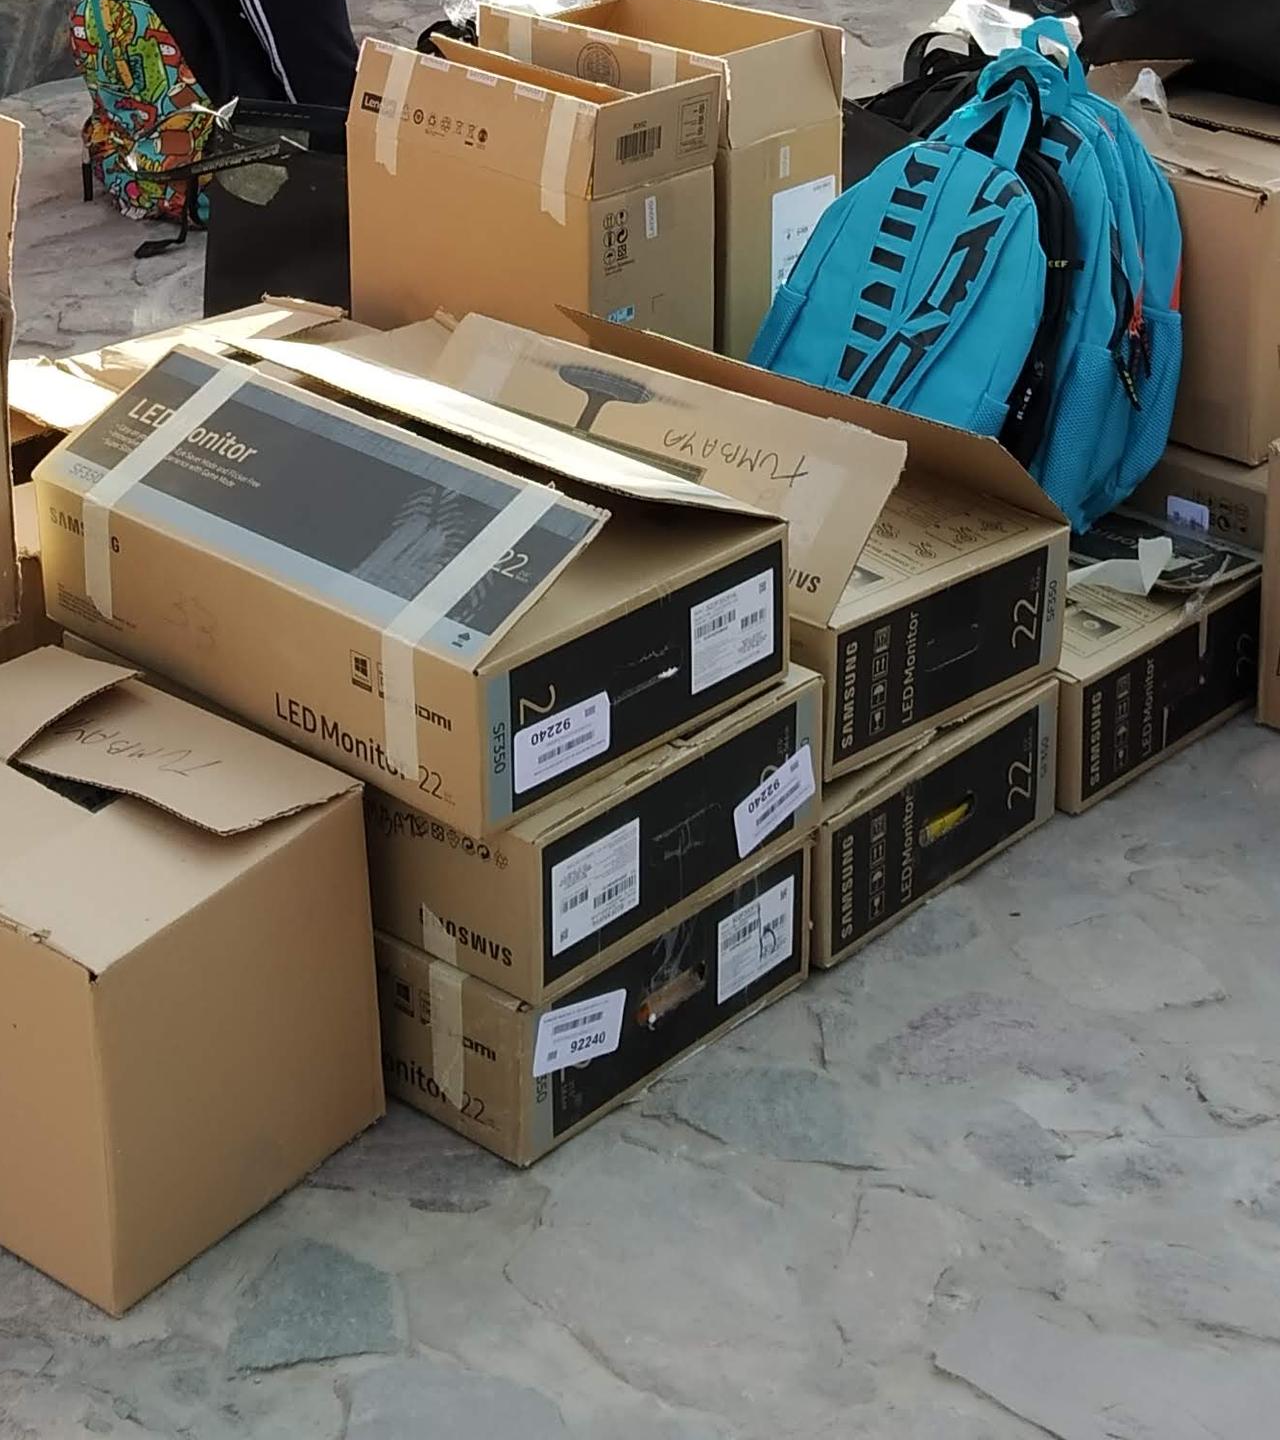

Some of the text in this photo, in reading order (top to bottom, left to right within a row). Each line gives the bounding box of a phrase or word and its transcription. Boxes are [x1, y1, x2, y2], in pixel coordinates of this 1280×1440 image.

[128, 398, 177, 428] LED
[187, 426, 258, 463] onitor
[663, 428, 809, 488] TUMBAYA
[49, 507, 120, 553] SAMG
[1011, 593, 1040, 649] 22
[415, 704, 452, 732] DMI
[841, 641, 858, 749] SAMSUNG
[321, 716, 406, 780] Monit
[492, 722, 506, 774] SF350
[531, 717, 571, 746] 92240
[1089, 691, 1103, 787] SAMSUNG
[418, 765, 443, 800] 22
[748, 778, 781, 814] 92240
[1007, 752, 1032, 810] 22
[841, 835, 855, 939] SAMSUNG
[420, 906, 513, 967] SAMSU
[570, 1031, 606, 1054] 92240
